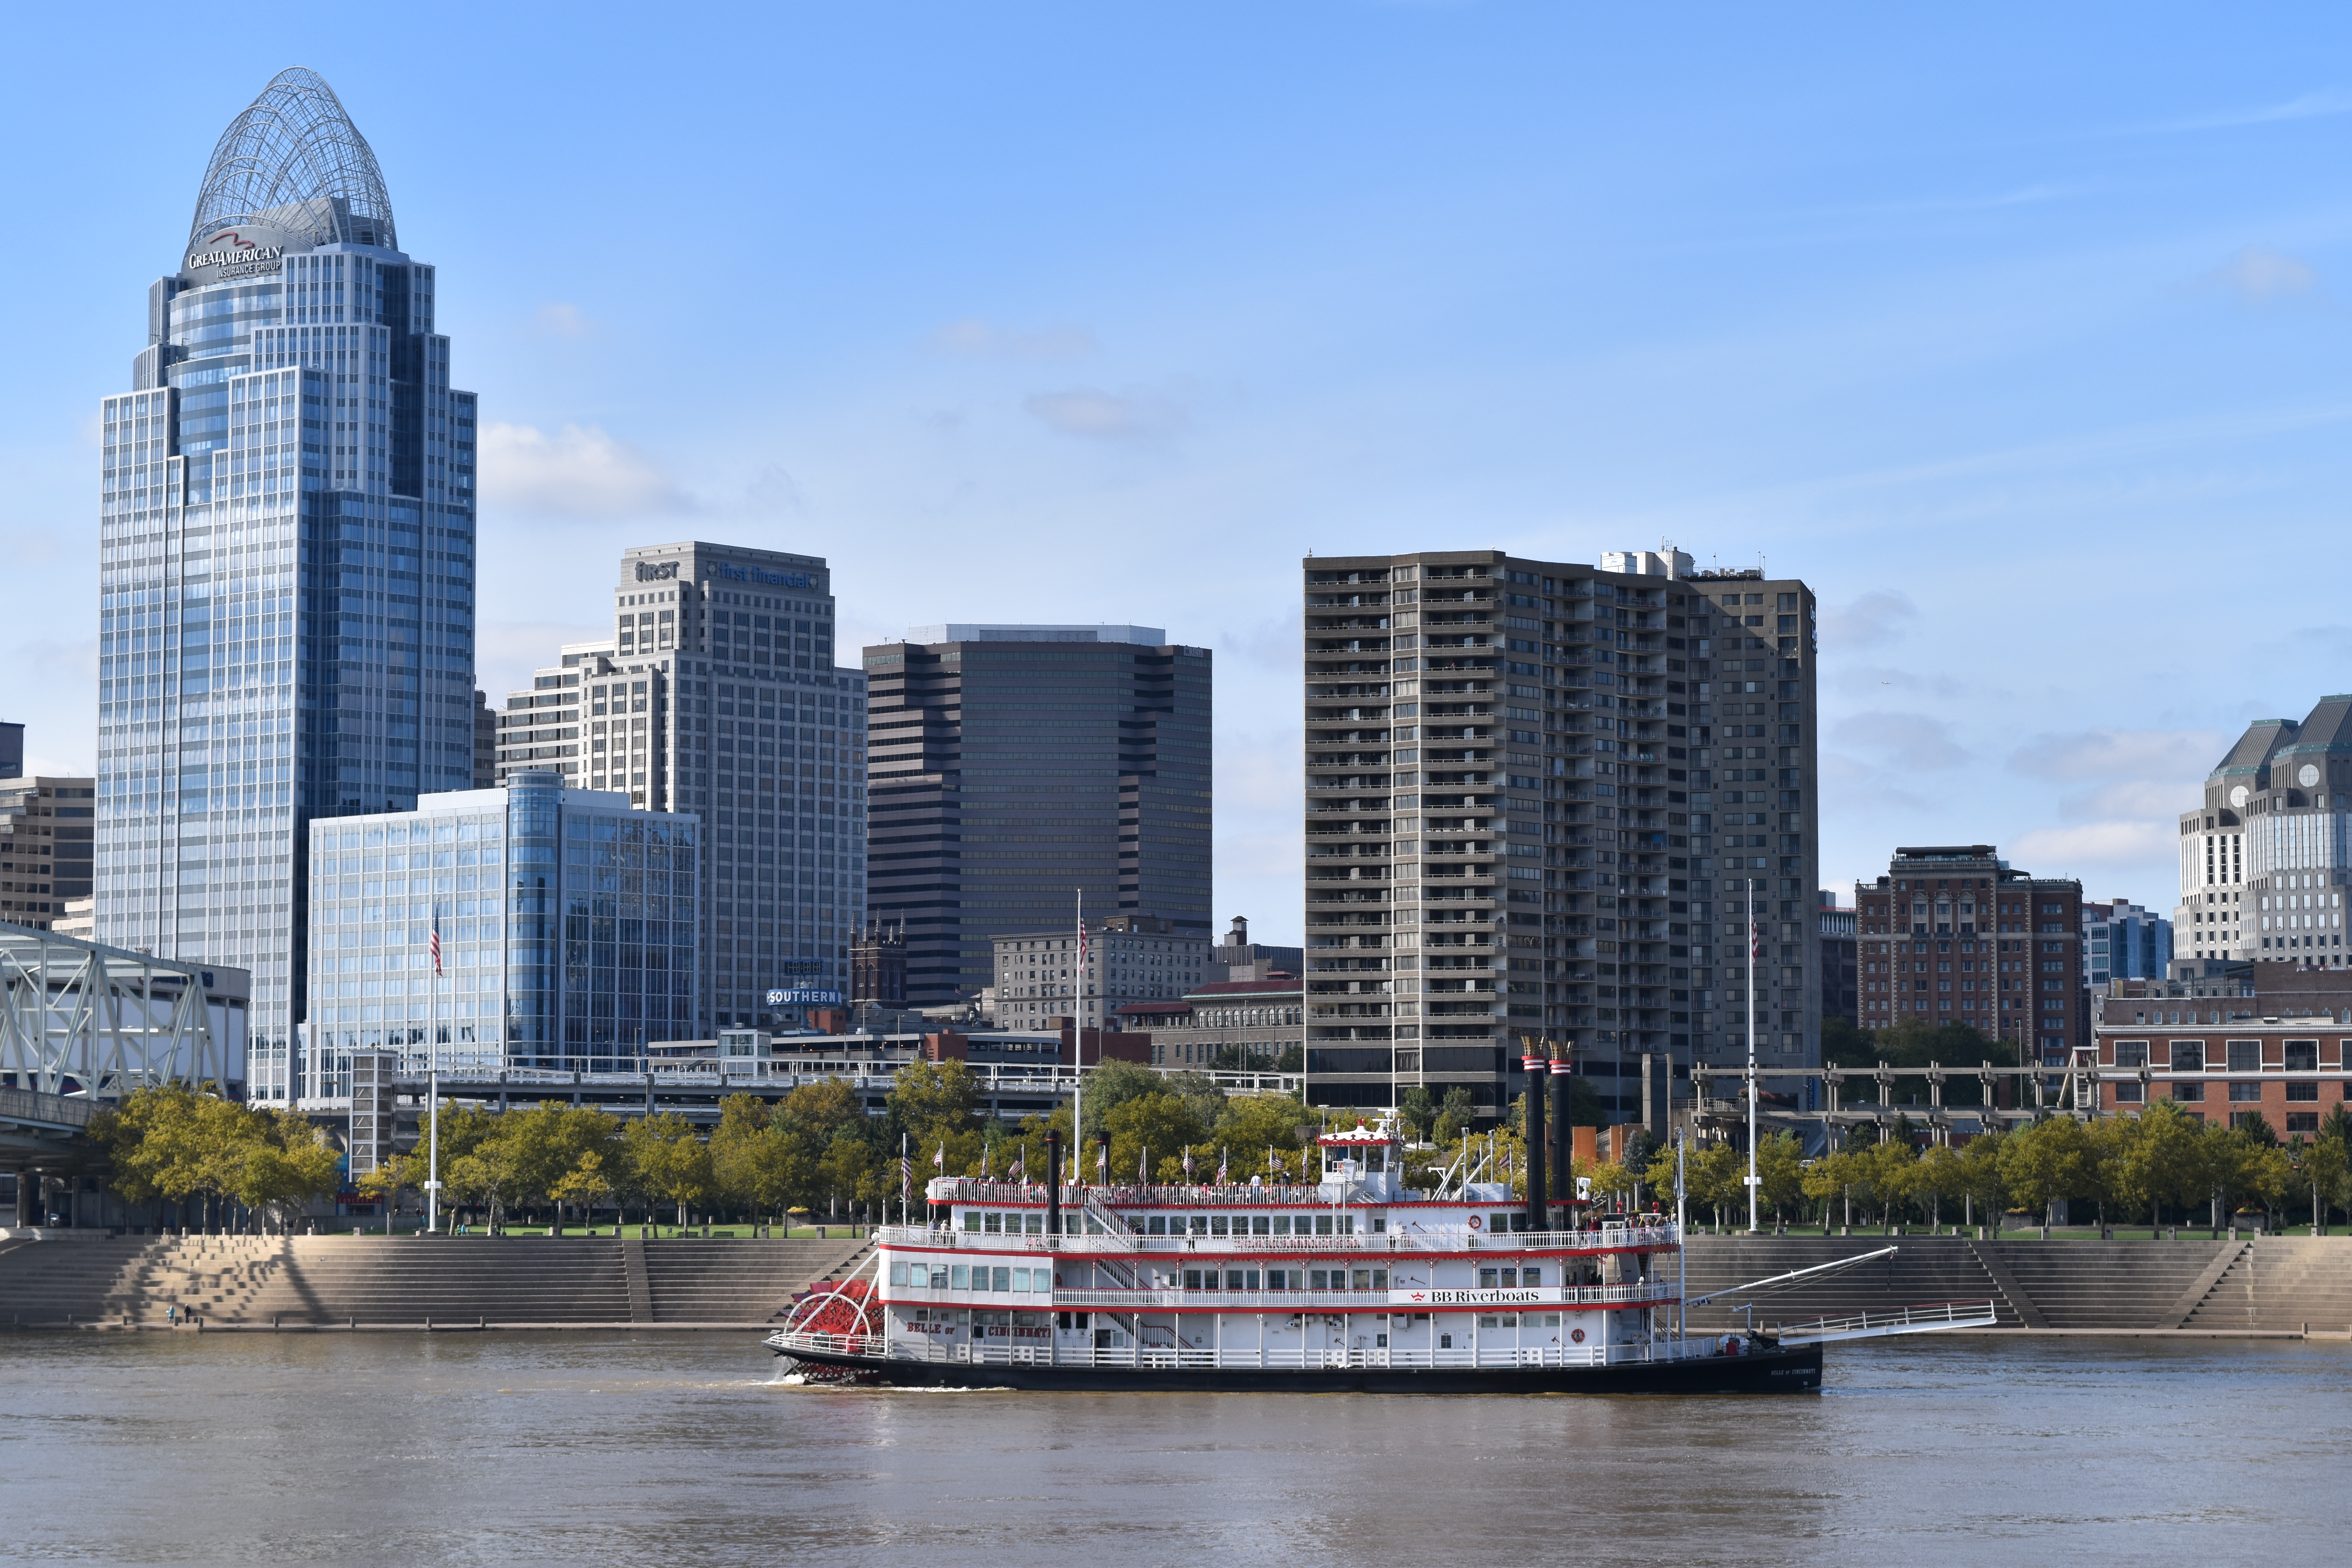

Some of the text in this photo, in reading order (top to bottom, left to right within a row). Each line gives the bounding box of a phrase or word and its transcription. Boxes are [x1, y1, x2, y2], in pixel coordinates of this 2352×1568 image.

[217, 261, 281, 278] INSURANCE GROUP
[720, 562, 809, 588] first financial
[1431, 1290, 1539, 1302] BB Riverboats
[907, 1322, 941, 1334] BELLE
[988, 1326, 1051, 1338] CINCINNATI
